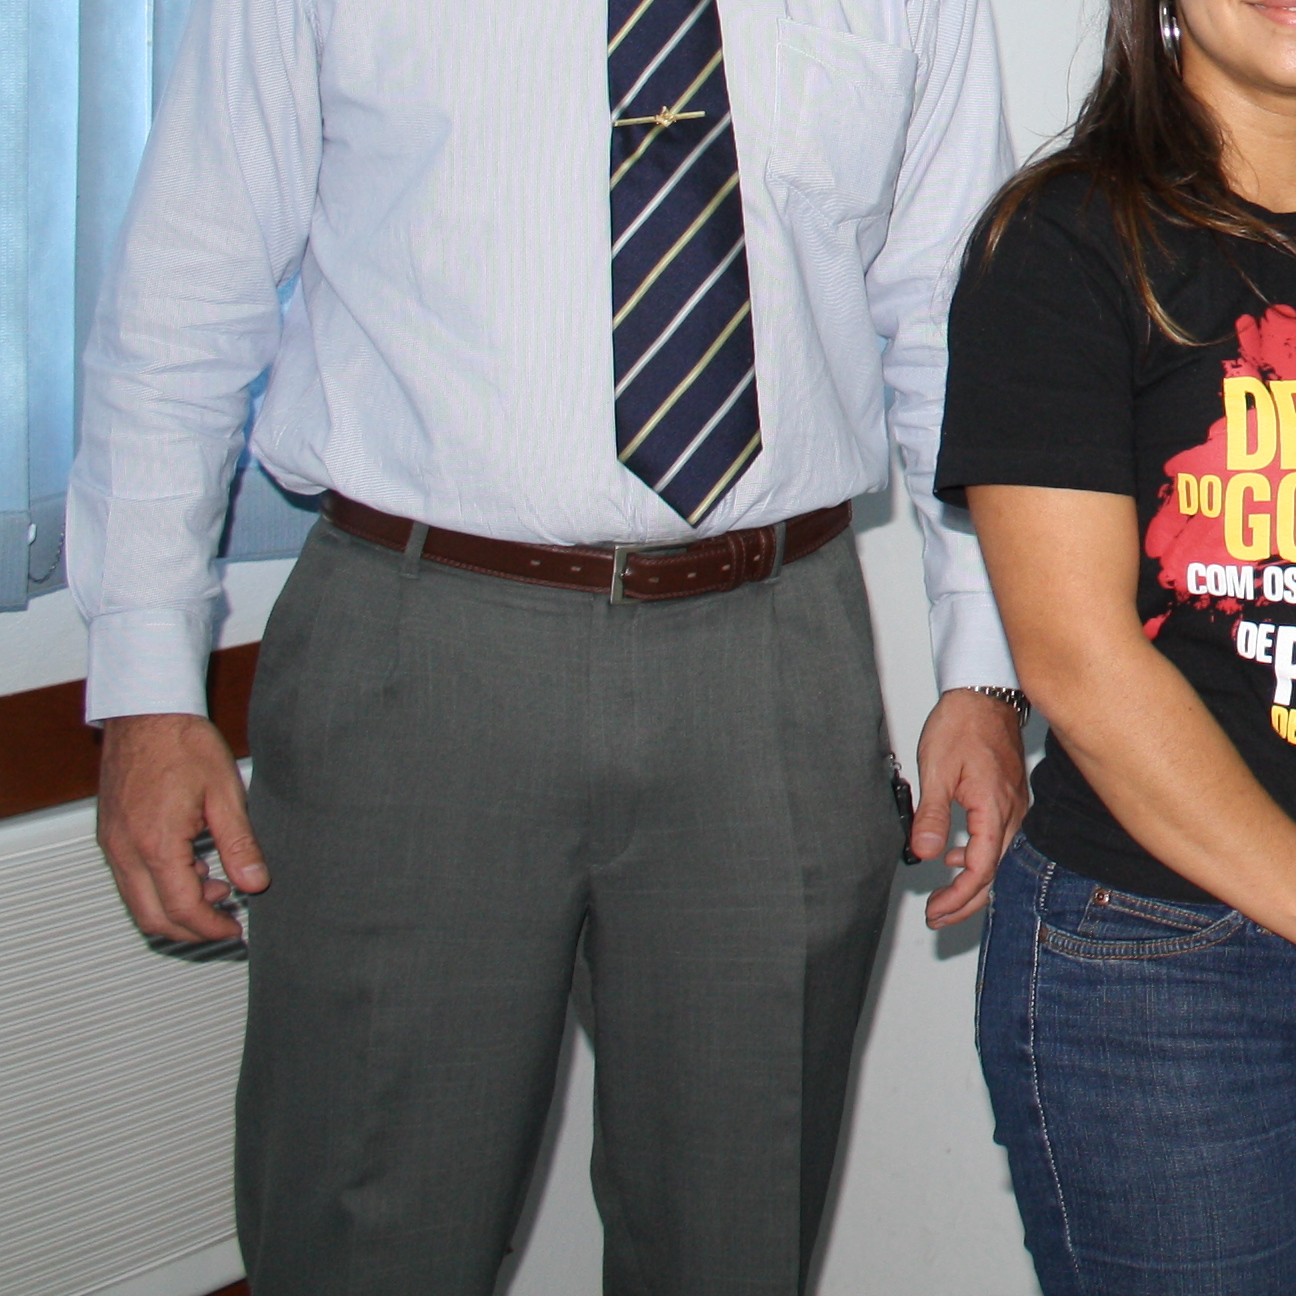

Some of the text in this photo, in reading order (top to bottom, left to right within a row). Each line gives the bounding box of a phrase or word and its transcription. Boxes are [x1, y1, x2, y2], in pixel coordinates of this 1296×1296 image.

[1177, 472, 1223, 519] DO
[1186, 562, 1254, 601] COM
[1236, 621, 1274, 665] DE
